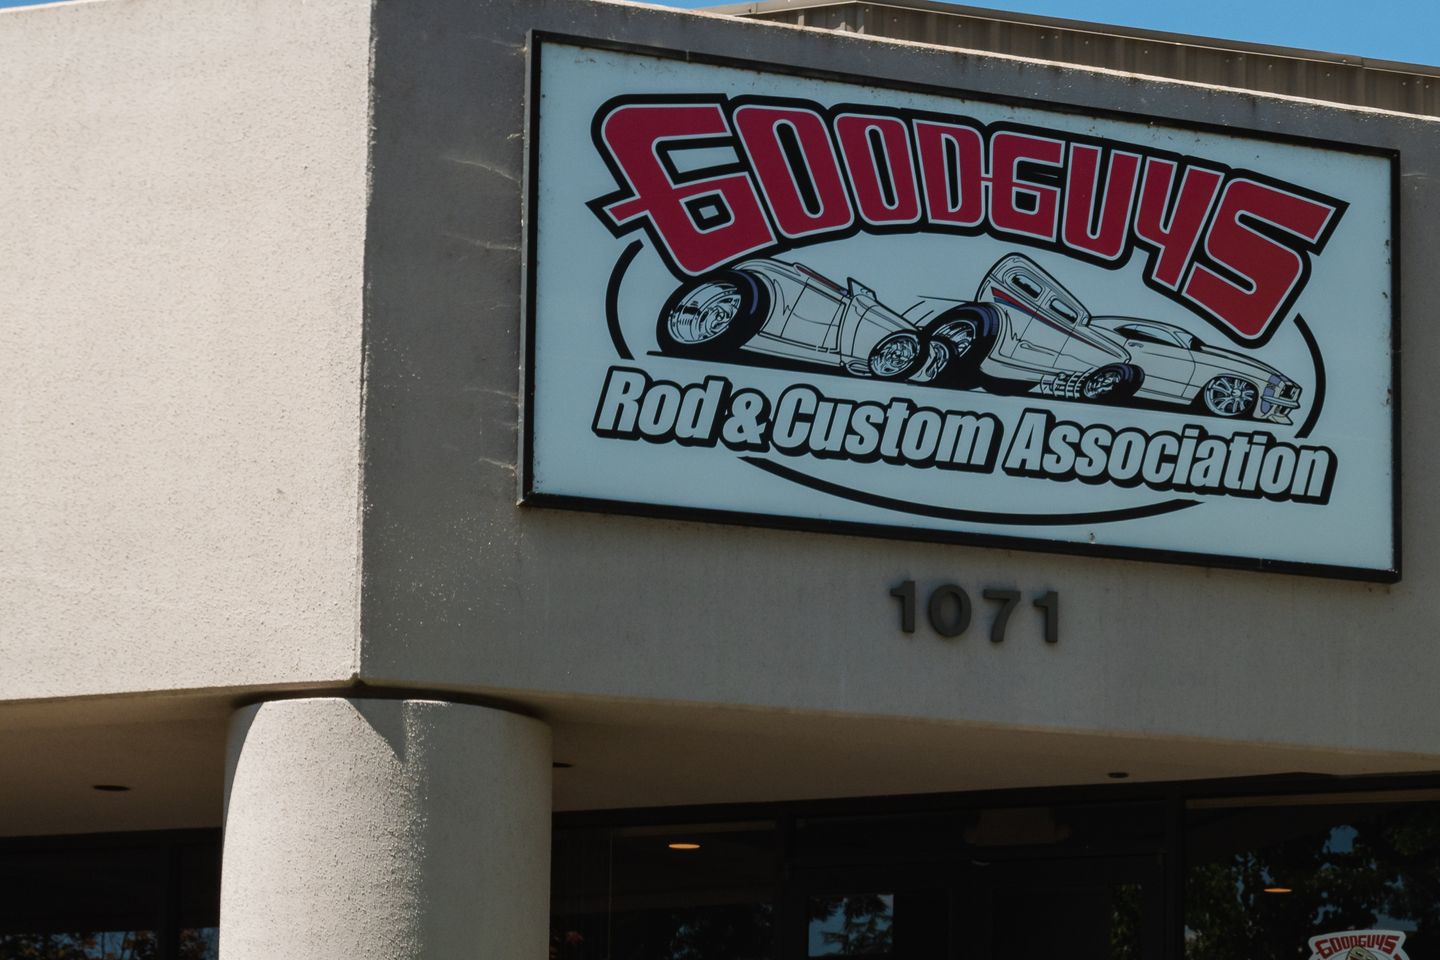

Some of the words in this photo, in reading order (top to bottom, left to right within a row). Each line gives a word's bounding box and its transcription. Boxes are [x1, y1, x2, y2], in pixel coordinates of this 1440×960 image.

[588, 95, 1348, 346] GOODGUYS
[594, 368, 729, 446] Rod
[771, 384, 1001, 473] Custom
[1003, 409, 1335, 503] Association
[890, 580, 1058, 643] 1071
[1315, 934, 1400, 959] GOODGUYS
